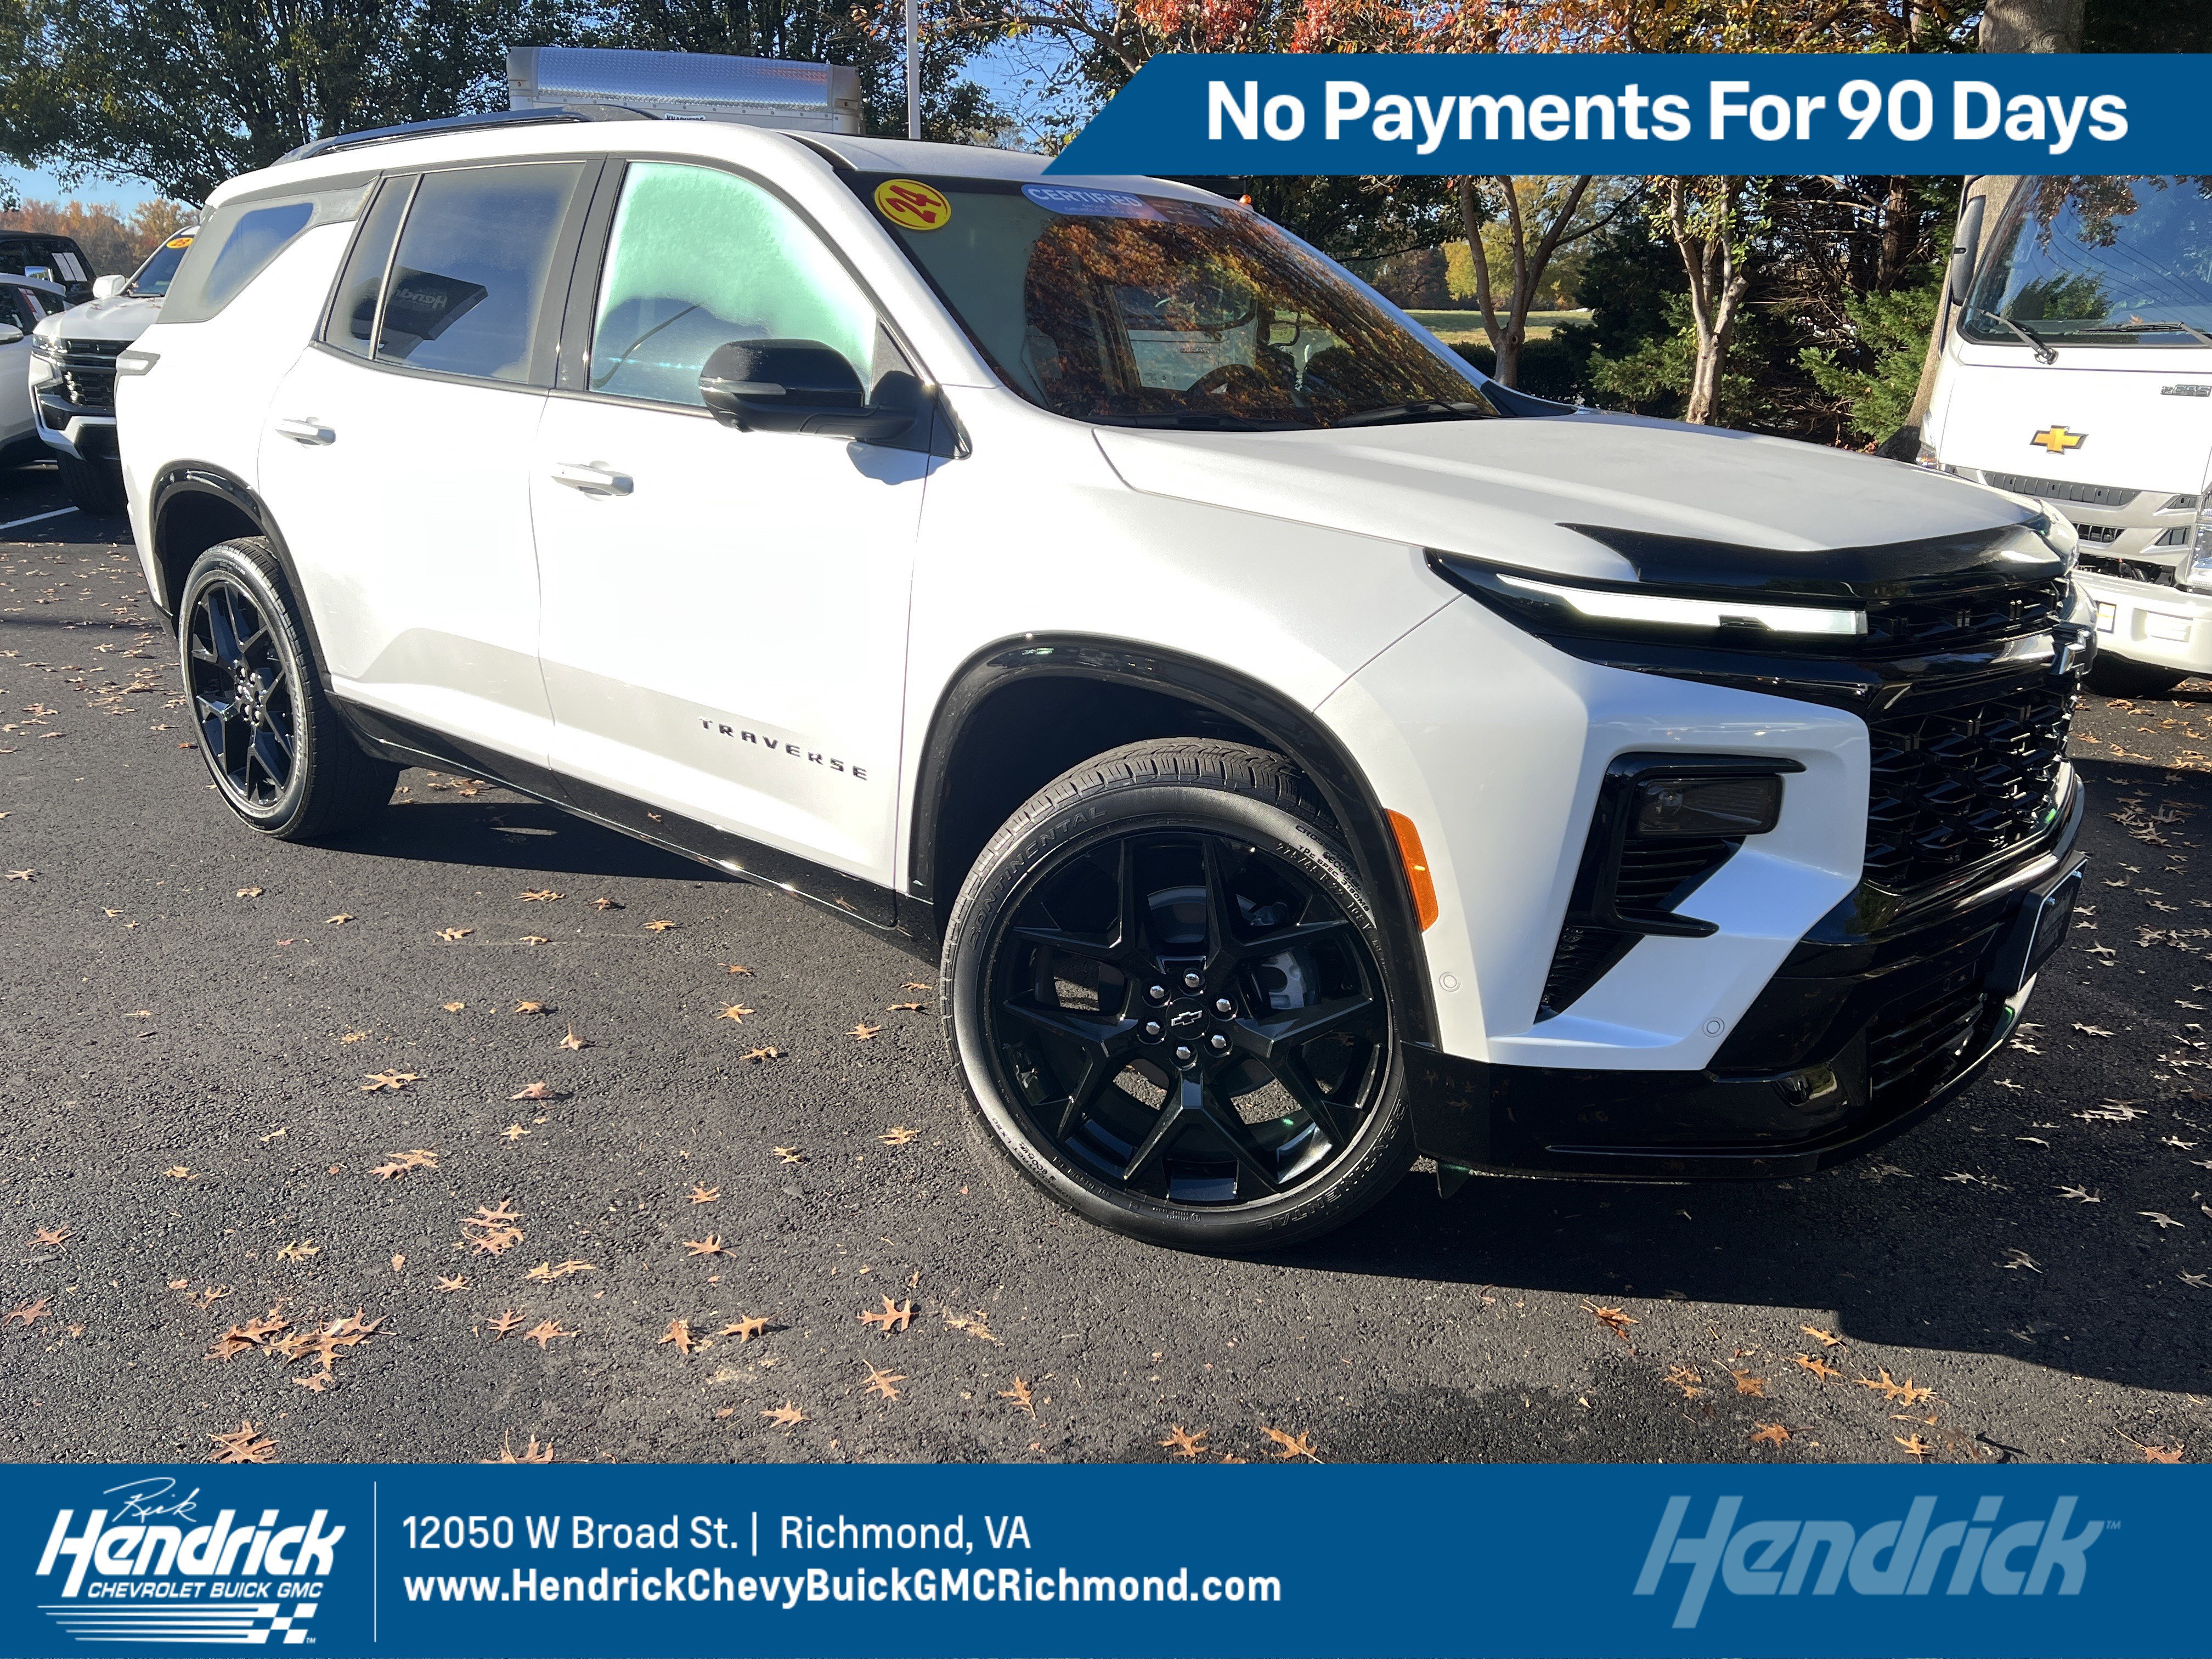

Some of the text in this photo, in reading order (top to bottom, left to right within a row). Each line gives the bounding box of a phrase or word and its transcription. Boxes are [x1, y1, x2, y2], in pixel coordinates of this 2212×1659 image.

[885, 185, 942, 223] 24
[1028, 188, 1143, 207] CERTIFIED
[696, 715, 868, 781] TRAVERSE
[967, 807, 1107, 950] CONTINENTAL
[1255, 1098, 1409, 1231] CONTINENTAL
